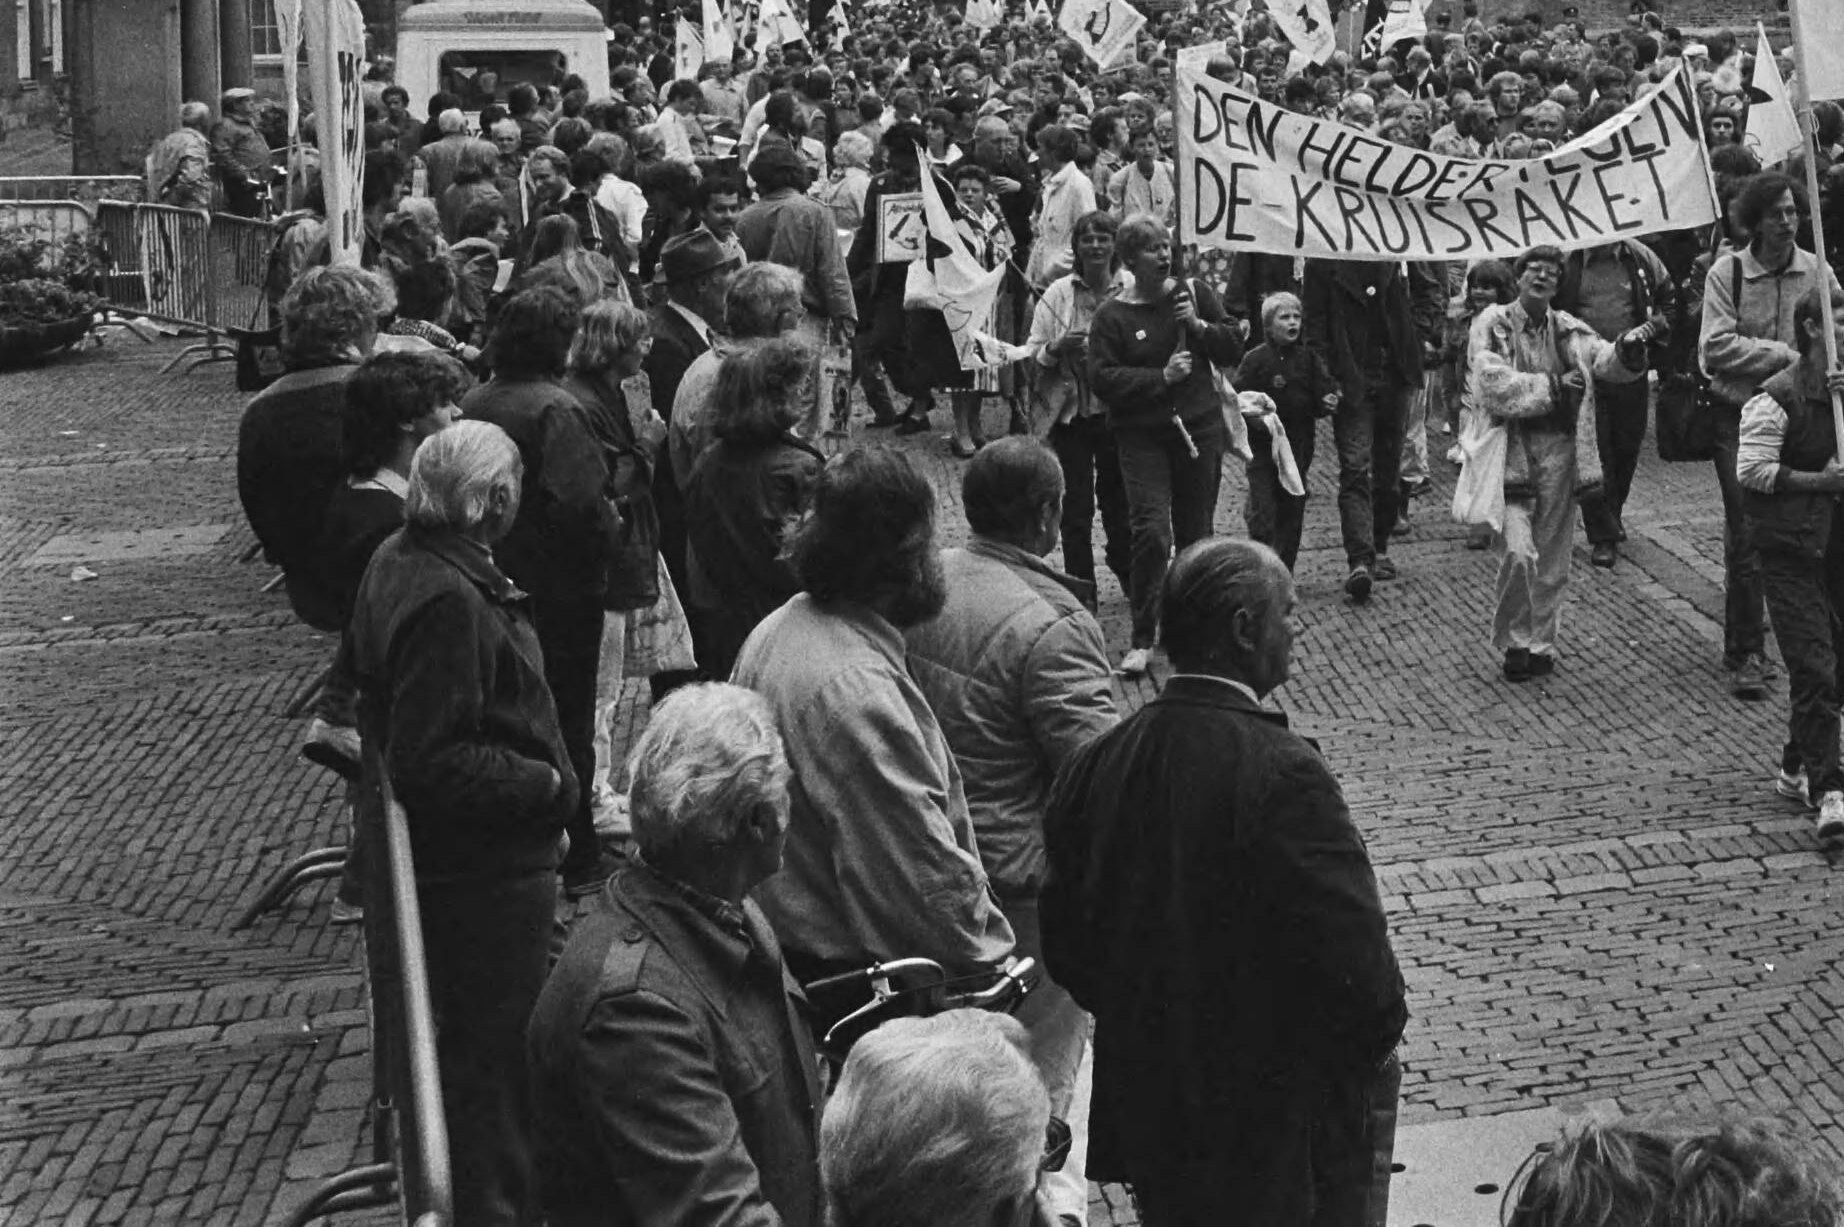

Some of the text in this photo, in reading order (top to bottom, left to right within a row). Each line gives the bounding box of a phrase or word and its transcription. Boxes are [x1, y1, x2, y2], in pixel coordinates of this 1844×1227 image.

[1193, 84, 1289, 162] DEN
[1299, 123, 1509, 201] HELDER
[1195, 149, 1672, 256] DE KRUISRAKET
